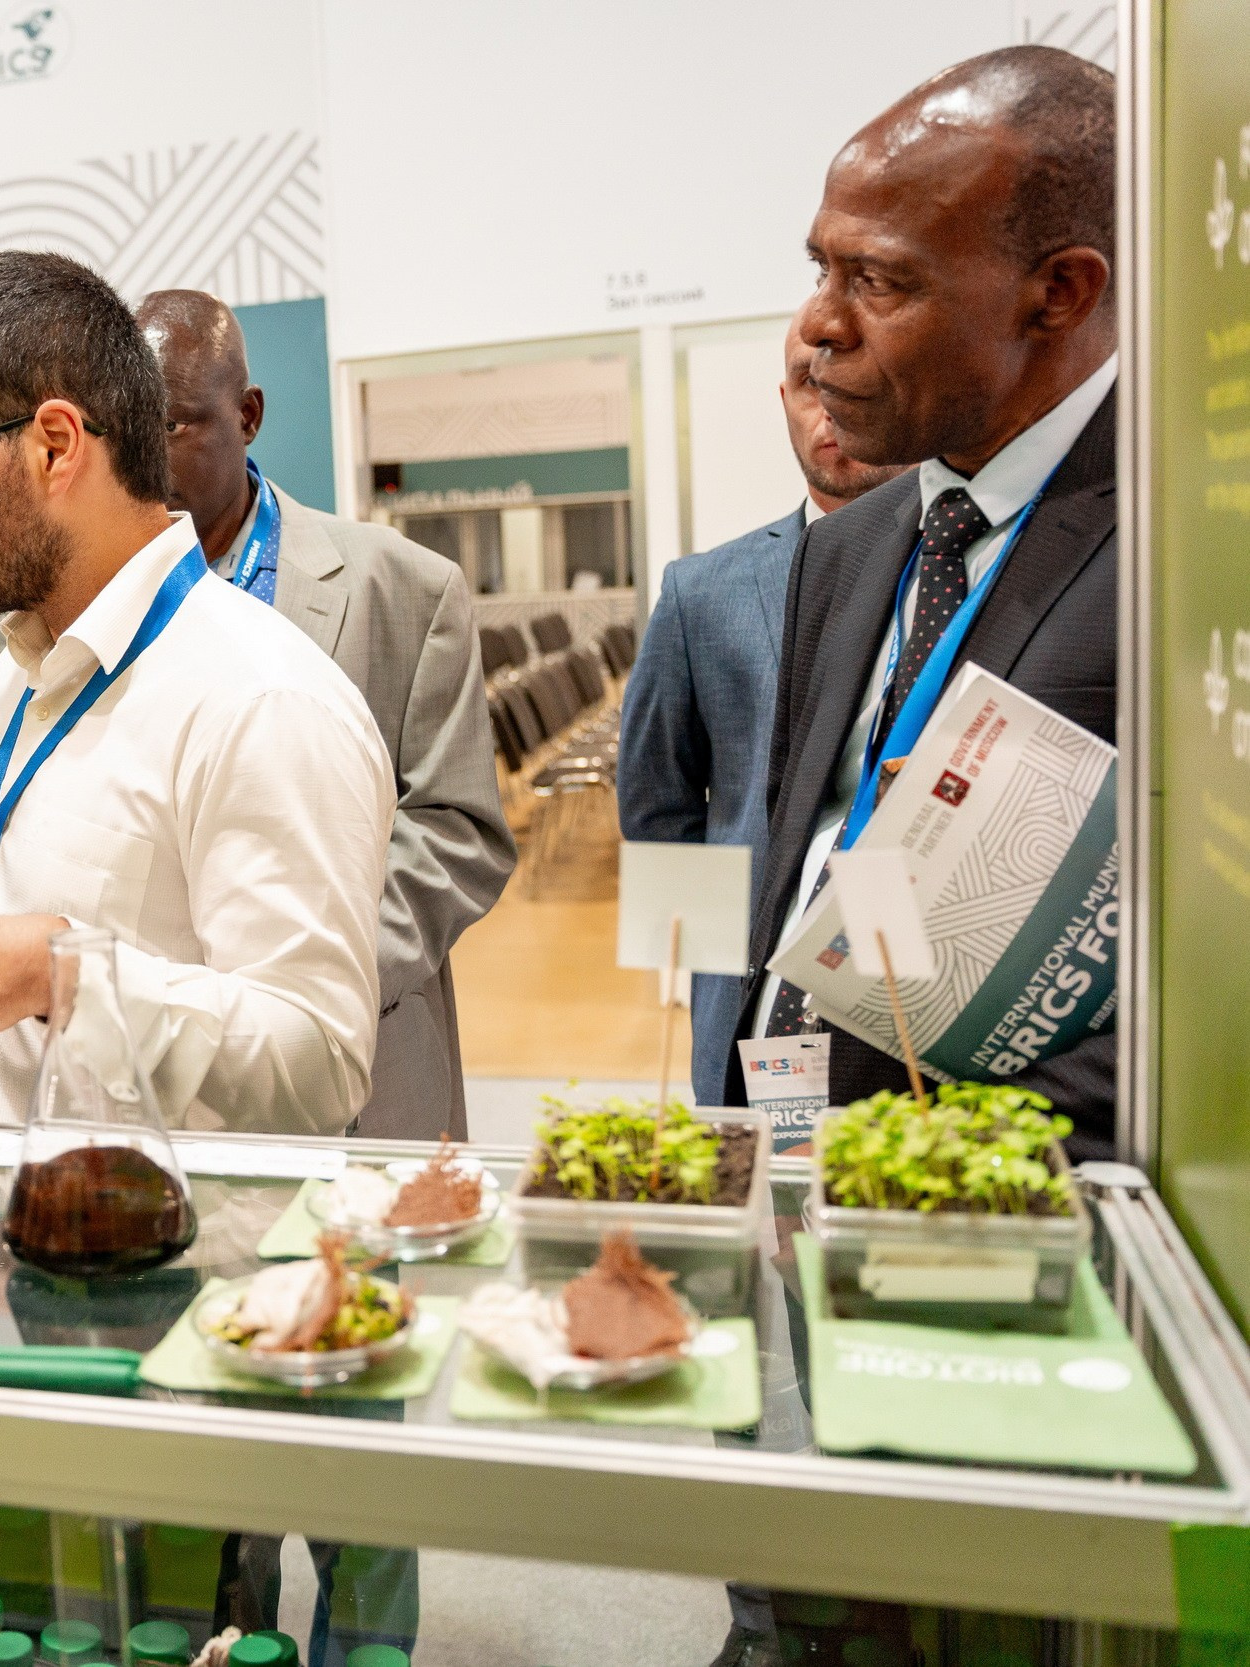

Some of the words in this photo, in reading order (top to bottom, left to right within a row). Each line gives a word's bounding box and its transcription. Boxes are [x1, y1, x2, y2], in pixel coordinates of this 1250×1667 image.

[949, 698, 999, 768] GOVERNMENT
[970, 916, 1092, 1067] INTERNATIONAL
[988, 964, 1092, 1076] BRICS
[769, 1108, 816, 1127] RICS
